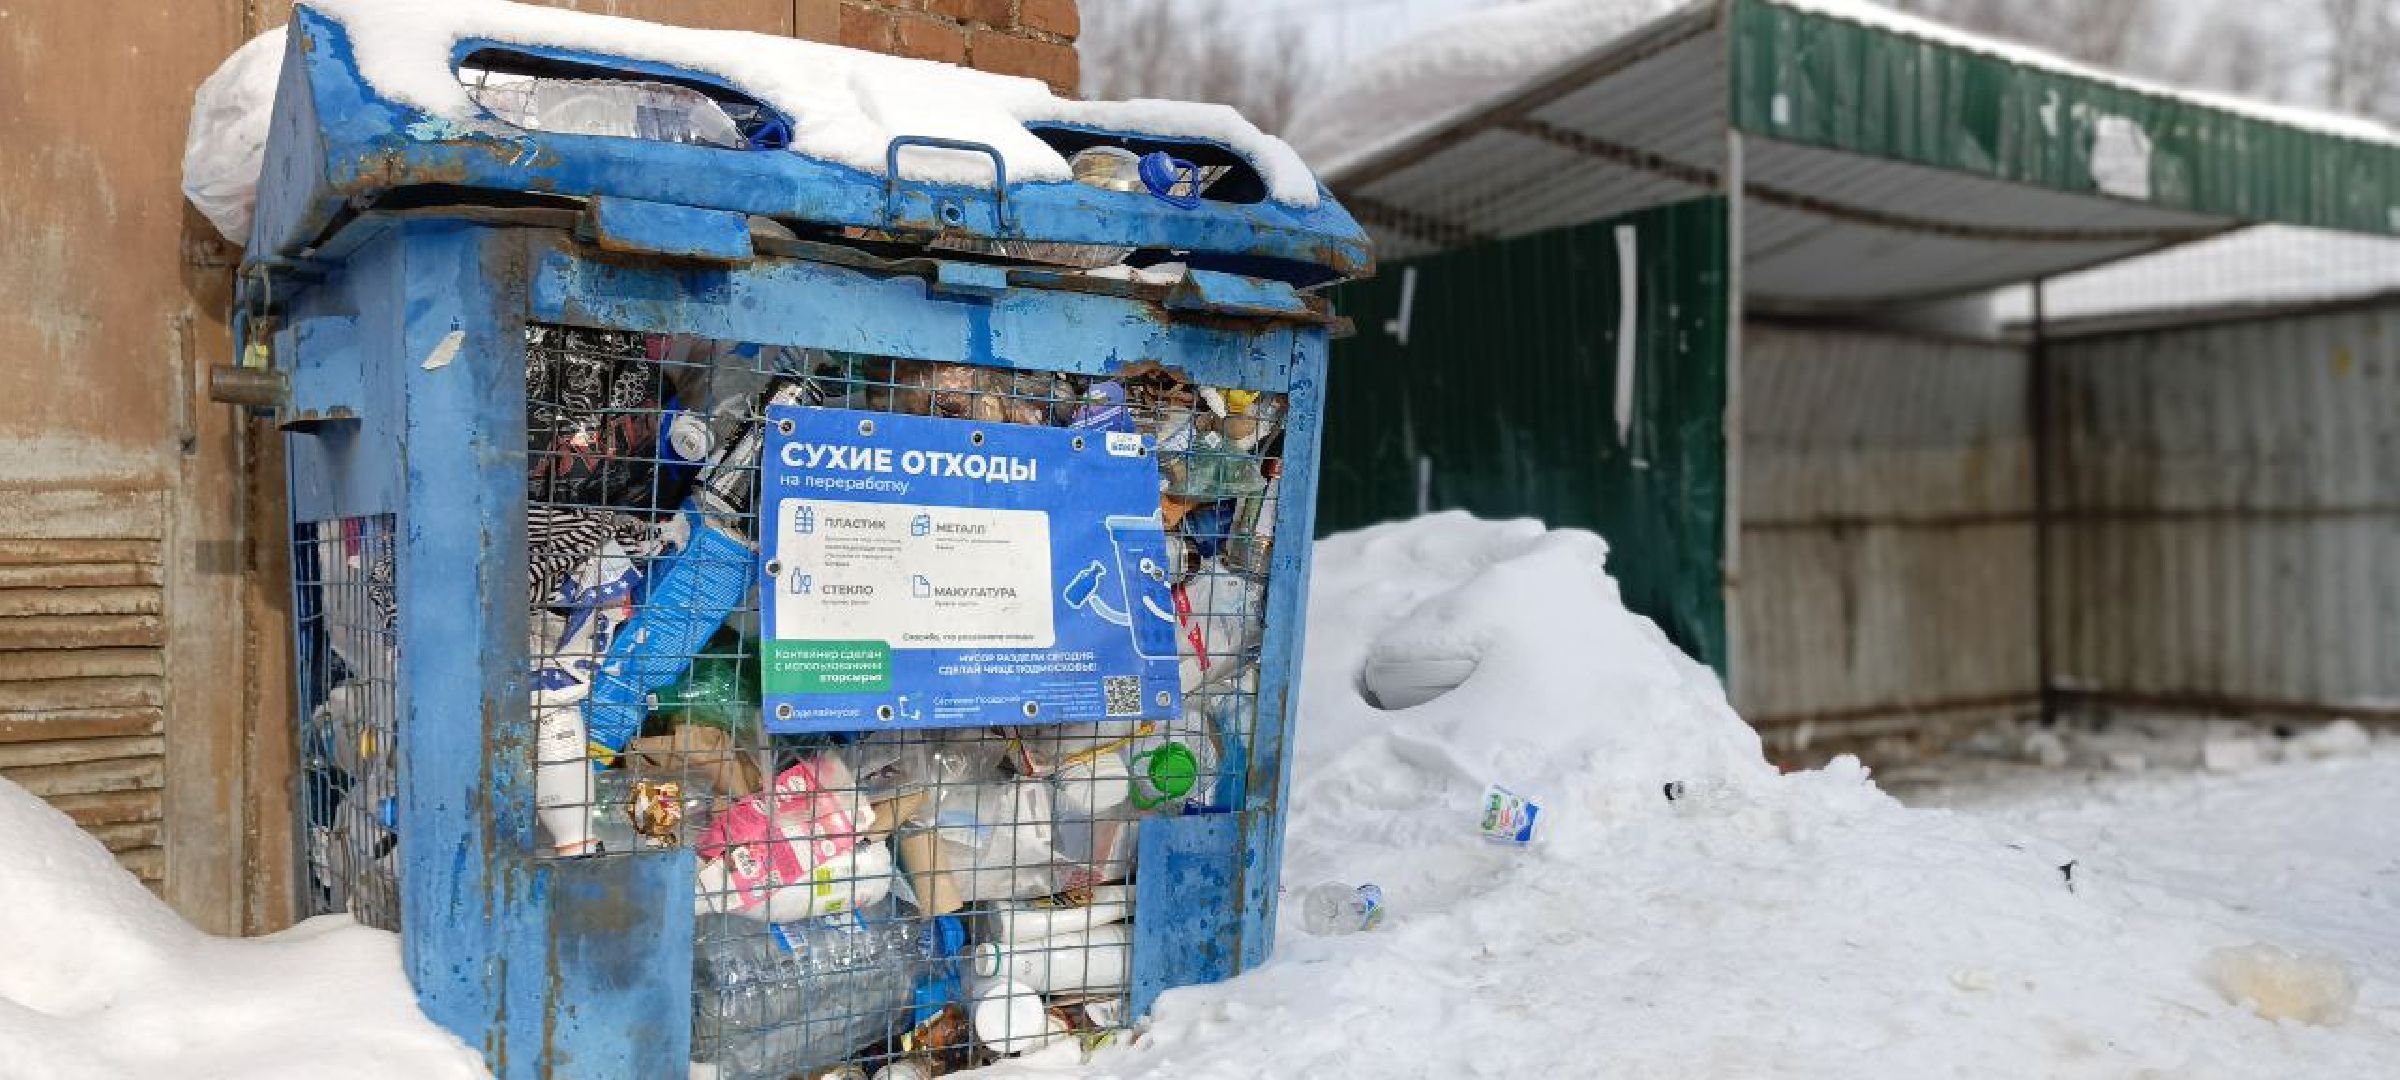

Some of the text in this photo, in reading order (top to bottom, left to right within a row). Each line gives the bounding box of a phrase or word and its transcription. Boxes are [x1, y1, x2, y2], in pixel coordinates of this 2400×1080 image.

[780, 441, 1037, 484] СУХИЕ ОТХОДЫ
[780, 474, 910, 496] на переработку
[824, 518, 886, 530] ПЛАСТИК
[936, 523, 986, 534] МЕТАЛЛ
[822, 585, 874, 595] СТЕКЛО
[934, 587, 1017, 598] МАКУЛАТУРА
[775, 648, 882, 661] Контейнер сделан
[959, 653, 996, 663] МУСОР
[996, 652, 1046, 664] РАЗДЕЛИ
[775, 661, 882, 672] с использованием
[938, 663, 982, 675] СДЕЛАЙ
[983, 664, 1015, 675] ЧИЩЕ
